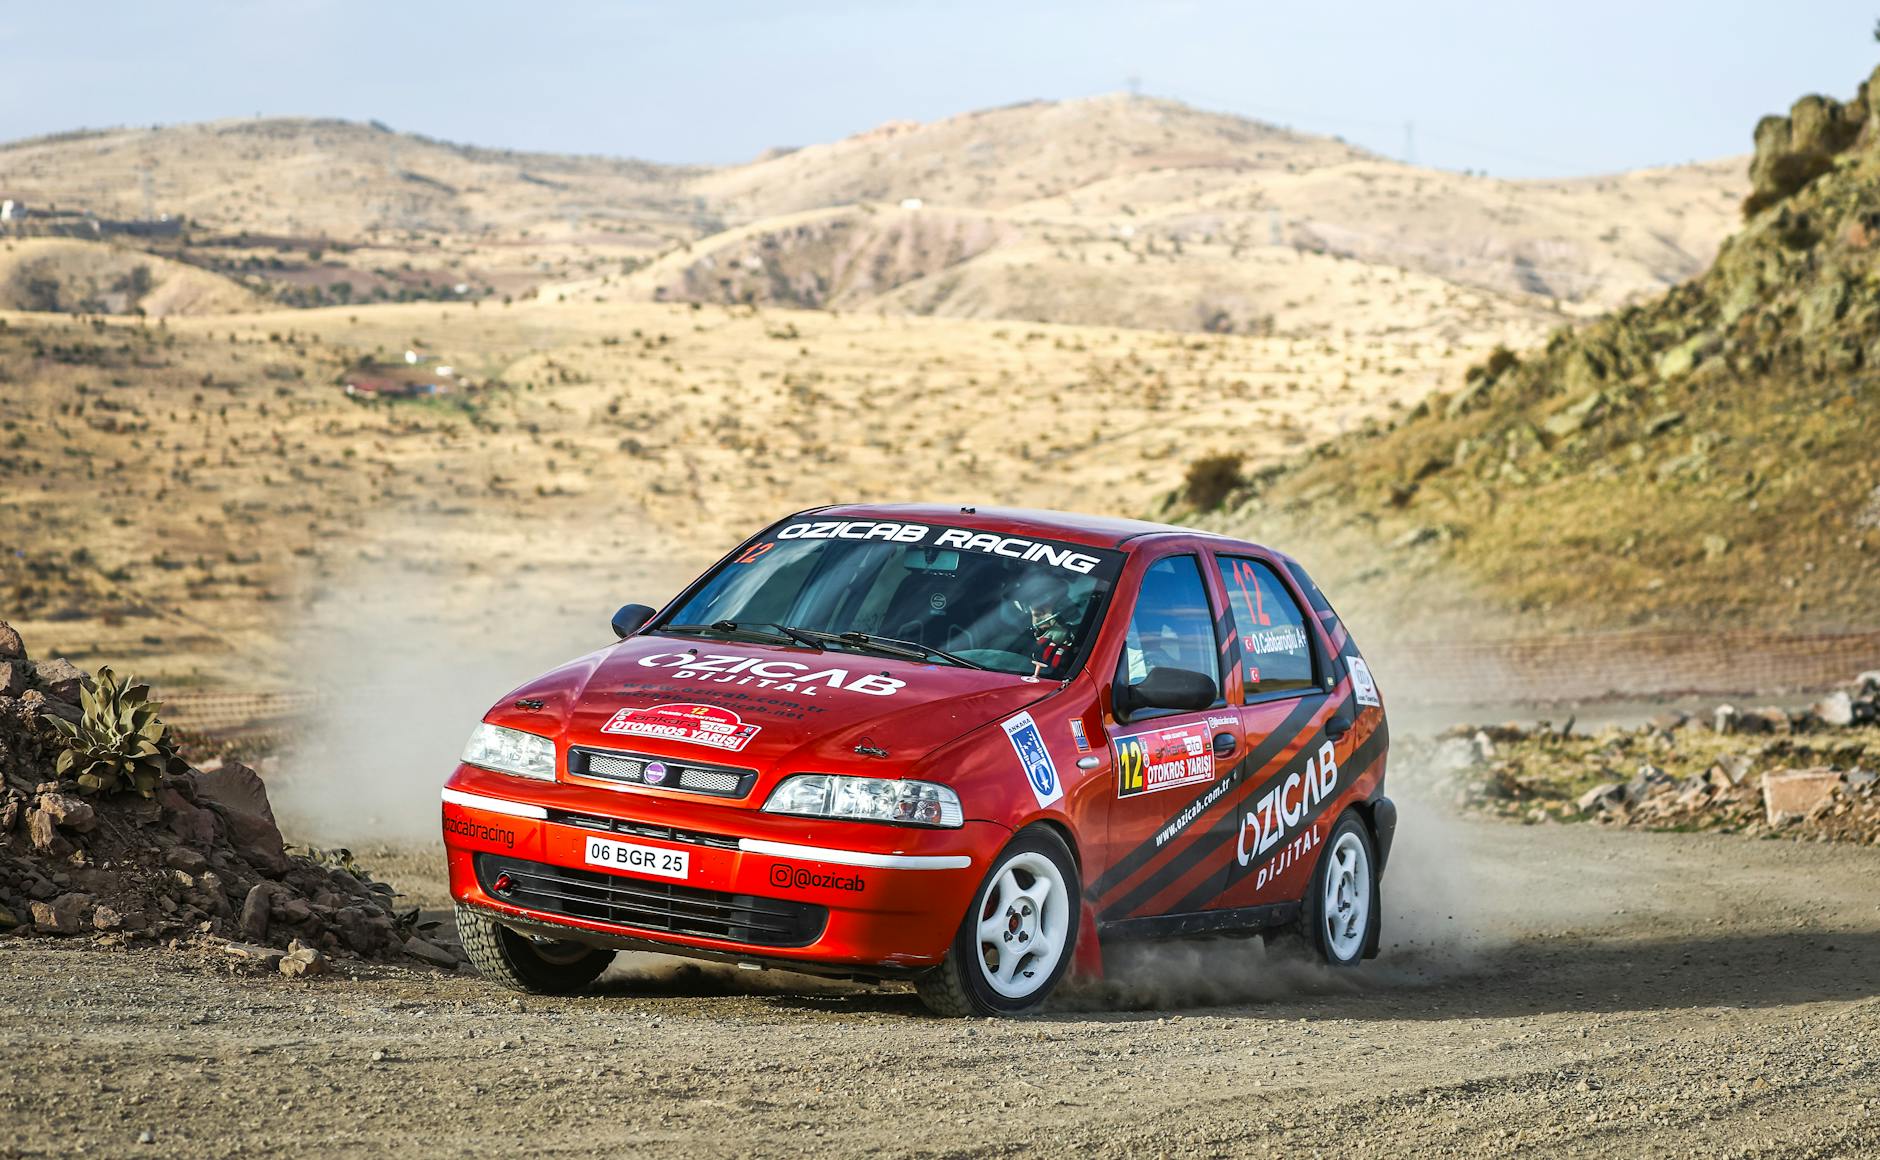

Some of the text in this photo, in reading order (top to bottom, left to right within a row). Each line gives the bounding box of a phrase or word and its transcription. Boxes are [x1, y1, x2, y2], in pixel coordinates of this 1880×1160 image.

[734, 541, 775, 564] 12
[777, 521, 1101, 575] OZICAB RACING
[1232, 560, 1271, 626] 12
[638, 653, 907, 697] OZICAB
[623, 683, 828, 713] www.ozicab.com.tr
[690, 706, 709, 715] 12
[611, 721, 743, 748] OTOKROS YARIŞI
[1008, 718, 1031, 734] ANKARA
[1121, 741, 1143, 790] 12
[1147, 755, 1212, 784] OTOKROS YARIŞI
[1155, 777, 1230, 847] www.ozicab.com.tr
[1237, 740, 1338, 867] OZICAB
[444, 812, 515, 849] ozicabracing
[591, 843, 683, 872] 06 BGR 25
[794, 868, 865, 892] @ozicab
